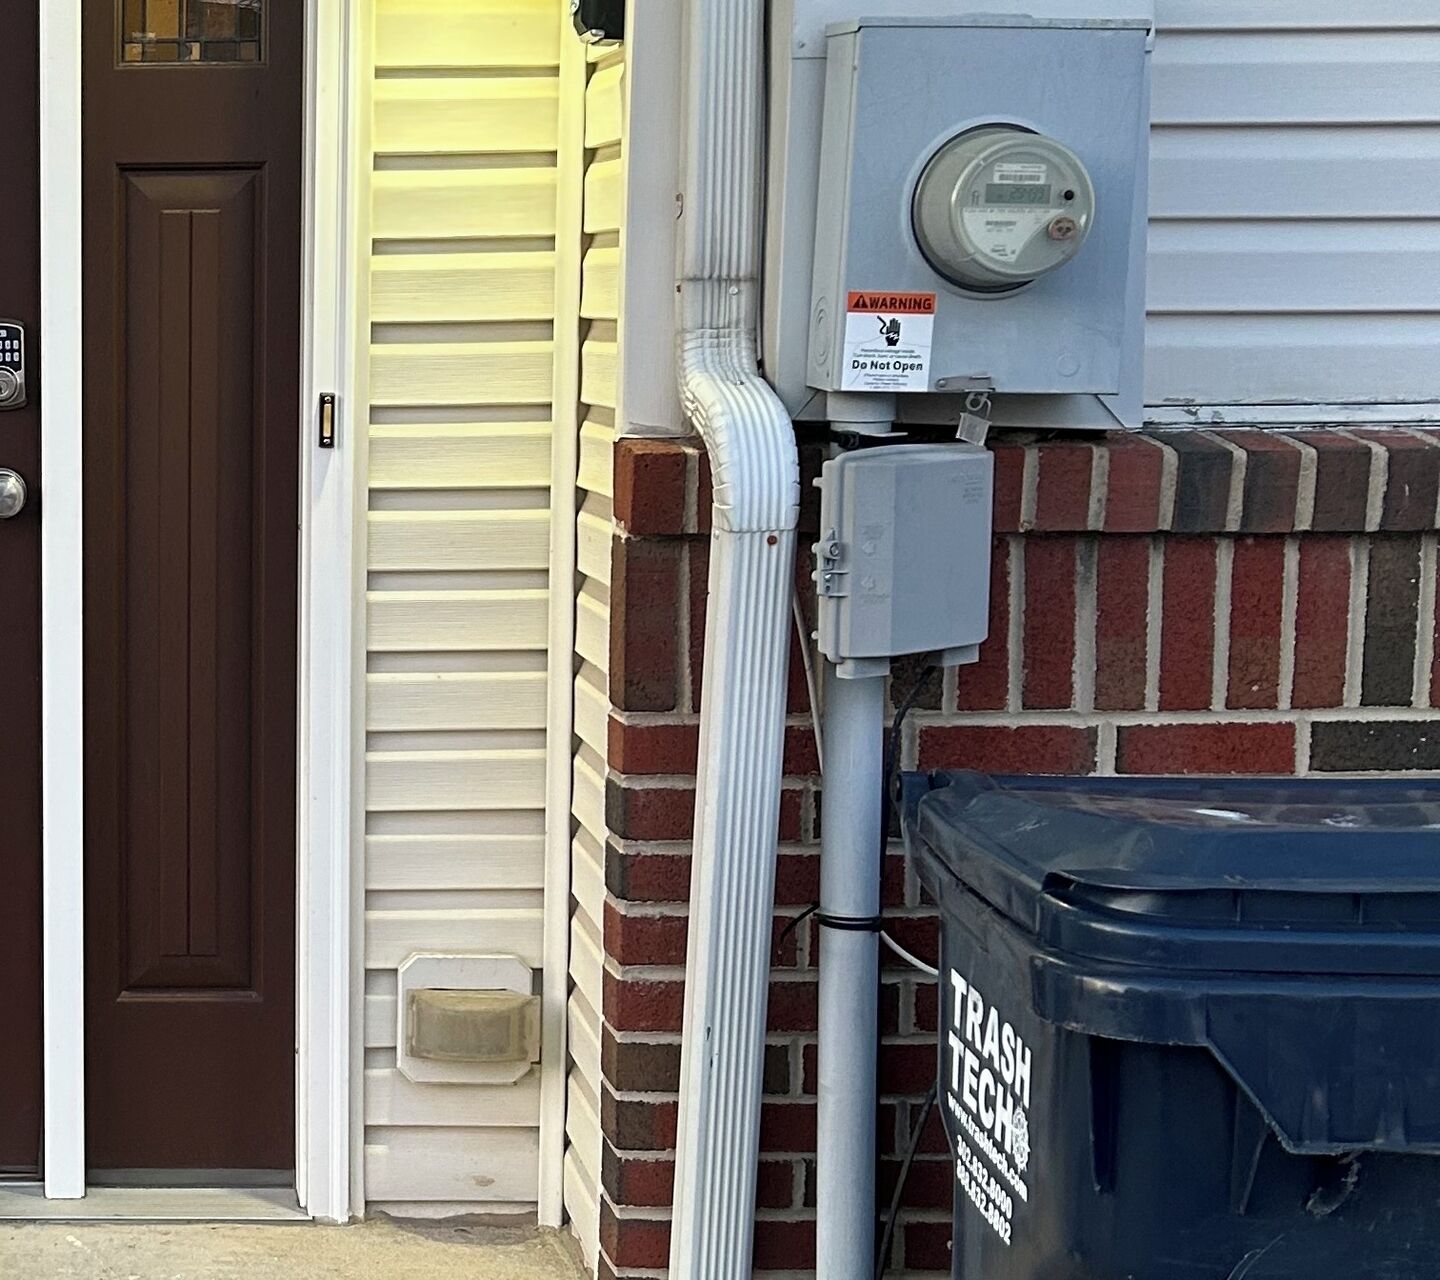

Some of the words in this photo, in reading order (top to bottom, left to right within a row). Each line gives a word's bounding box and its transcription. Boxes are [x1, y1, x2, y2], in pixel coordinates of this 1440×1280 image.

[869, 297, 932, 310] WARNING
[852, 360, 867, 370] Do
[870, 361, 890, 370] Not
[893, 361, 923, 373] Open
[948, 1030, 1014, 1154] TECH
[951, 968, 1031, 1109] TRASH
[948, 1092, 1027, 1202] www.trashtech.com
